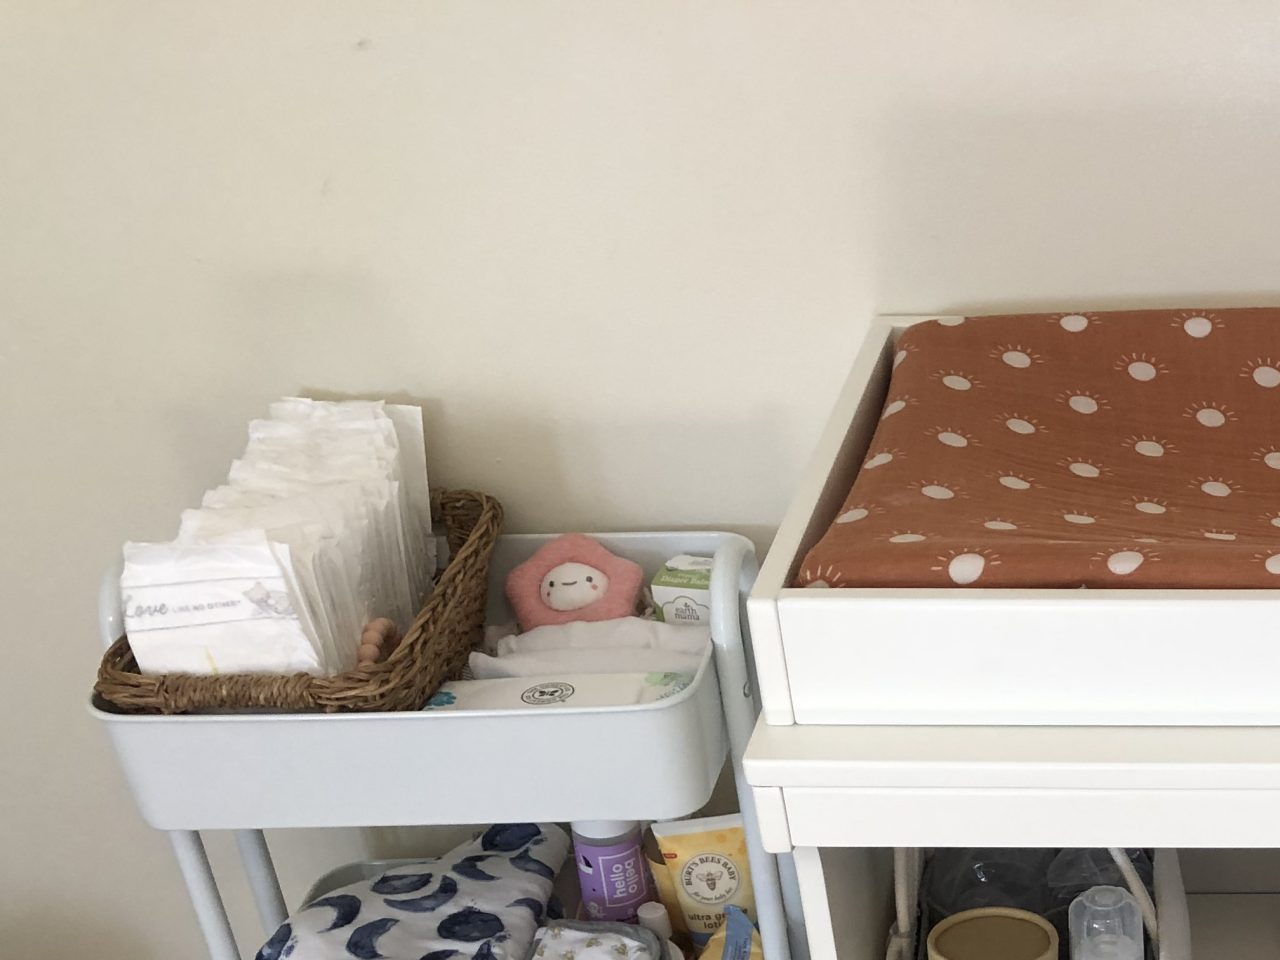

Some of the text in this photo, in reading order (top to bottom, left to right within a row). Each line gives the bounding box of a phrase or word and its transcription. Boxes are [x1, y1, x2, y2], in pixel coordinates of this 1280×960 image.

[674, 606, 698, 615] earth
[674, 613, 700, 621] mama
[698, 856, 722, 865] BEES
[721, 861, 737, 881] BABY
[609, 863, 628, 898] hello
[688, 913, 712, 921] ultra
